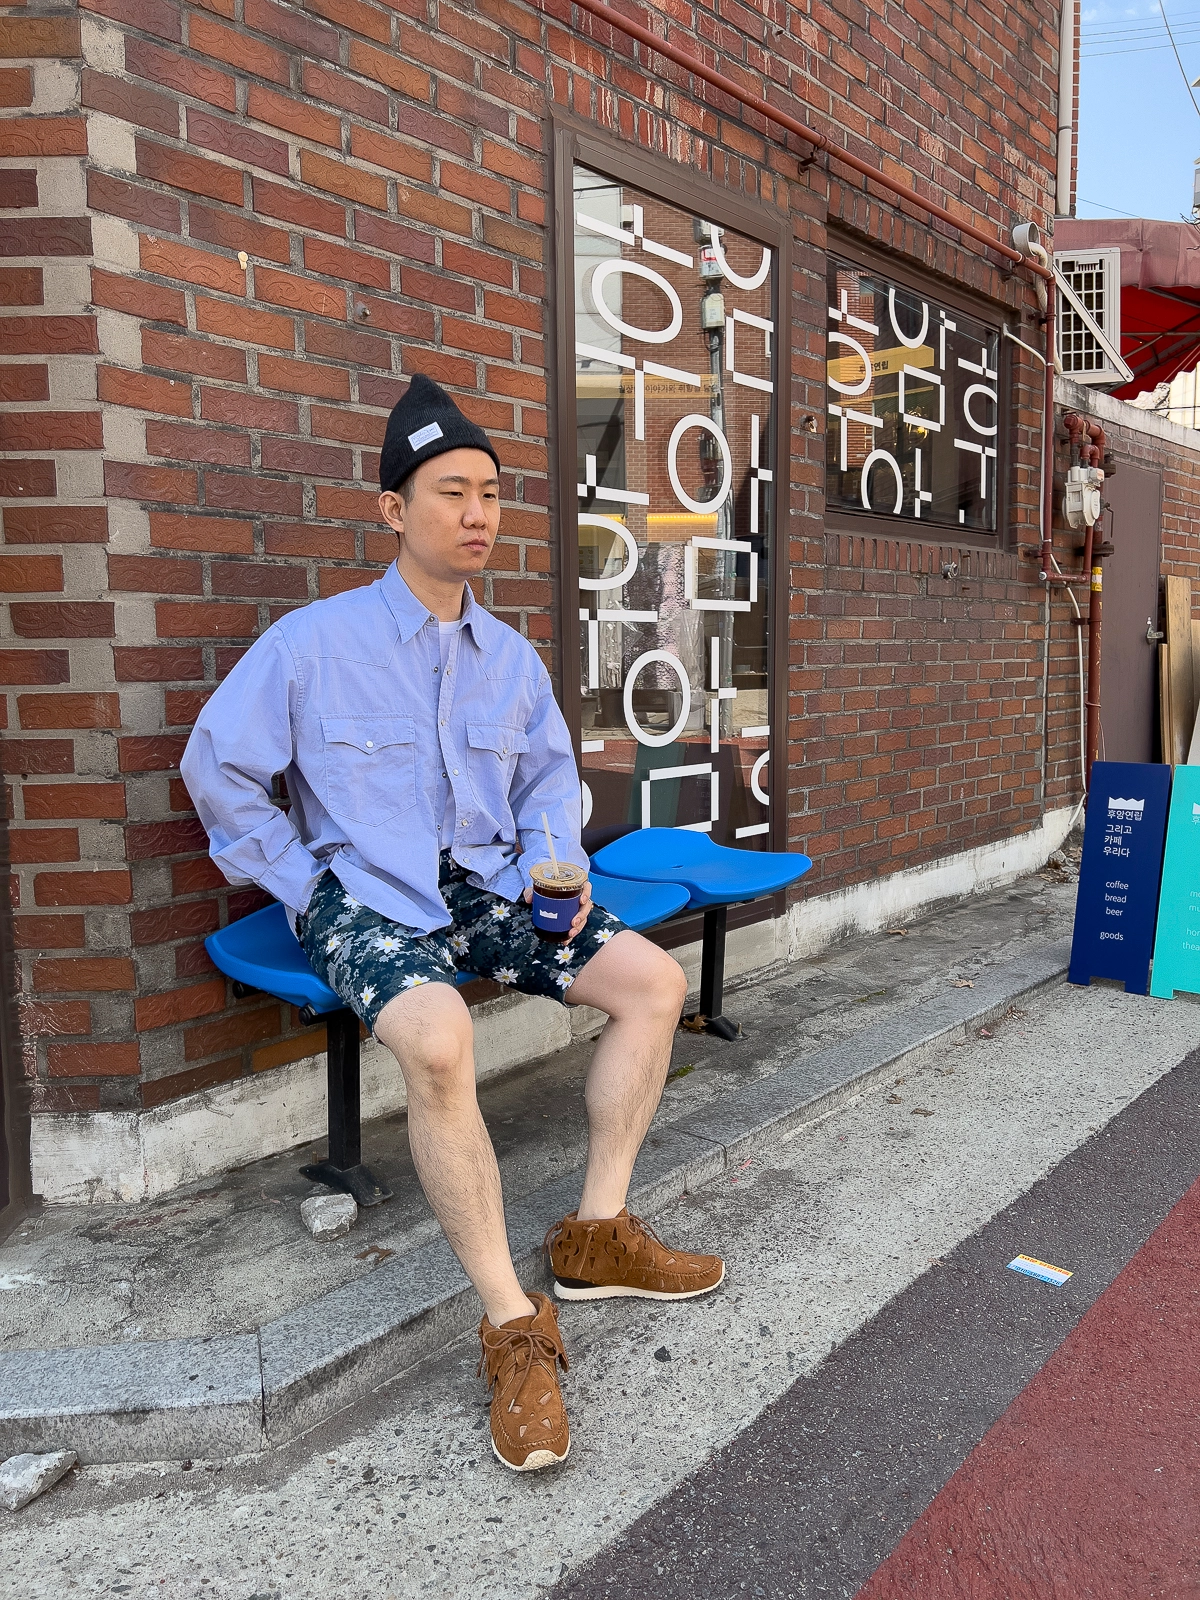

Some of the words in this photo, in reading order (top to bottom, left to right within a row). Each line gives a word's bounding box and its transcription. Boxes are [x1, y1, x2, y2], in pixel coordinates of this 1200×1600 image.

[1107, 810, 1142, 821] 후암연립
[1105, 824, 1132, 834] 그리고
[1104, 835, 1122, 846] 카페
[1103, 846, 1130, 857] 우리다
[1105, 880, 1129, 890] coffee
[1104, 893, 1127, 904] bread
[1105, 906, 1123, 917] beer
[1099, 931, 1124, 941] goods
